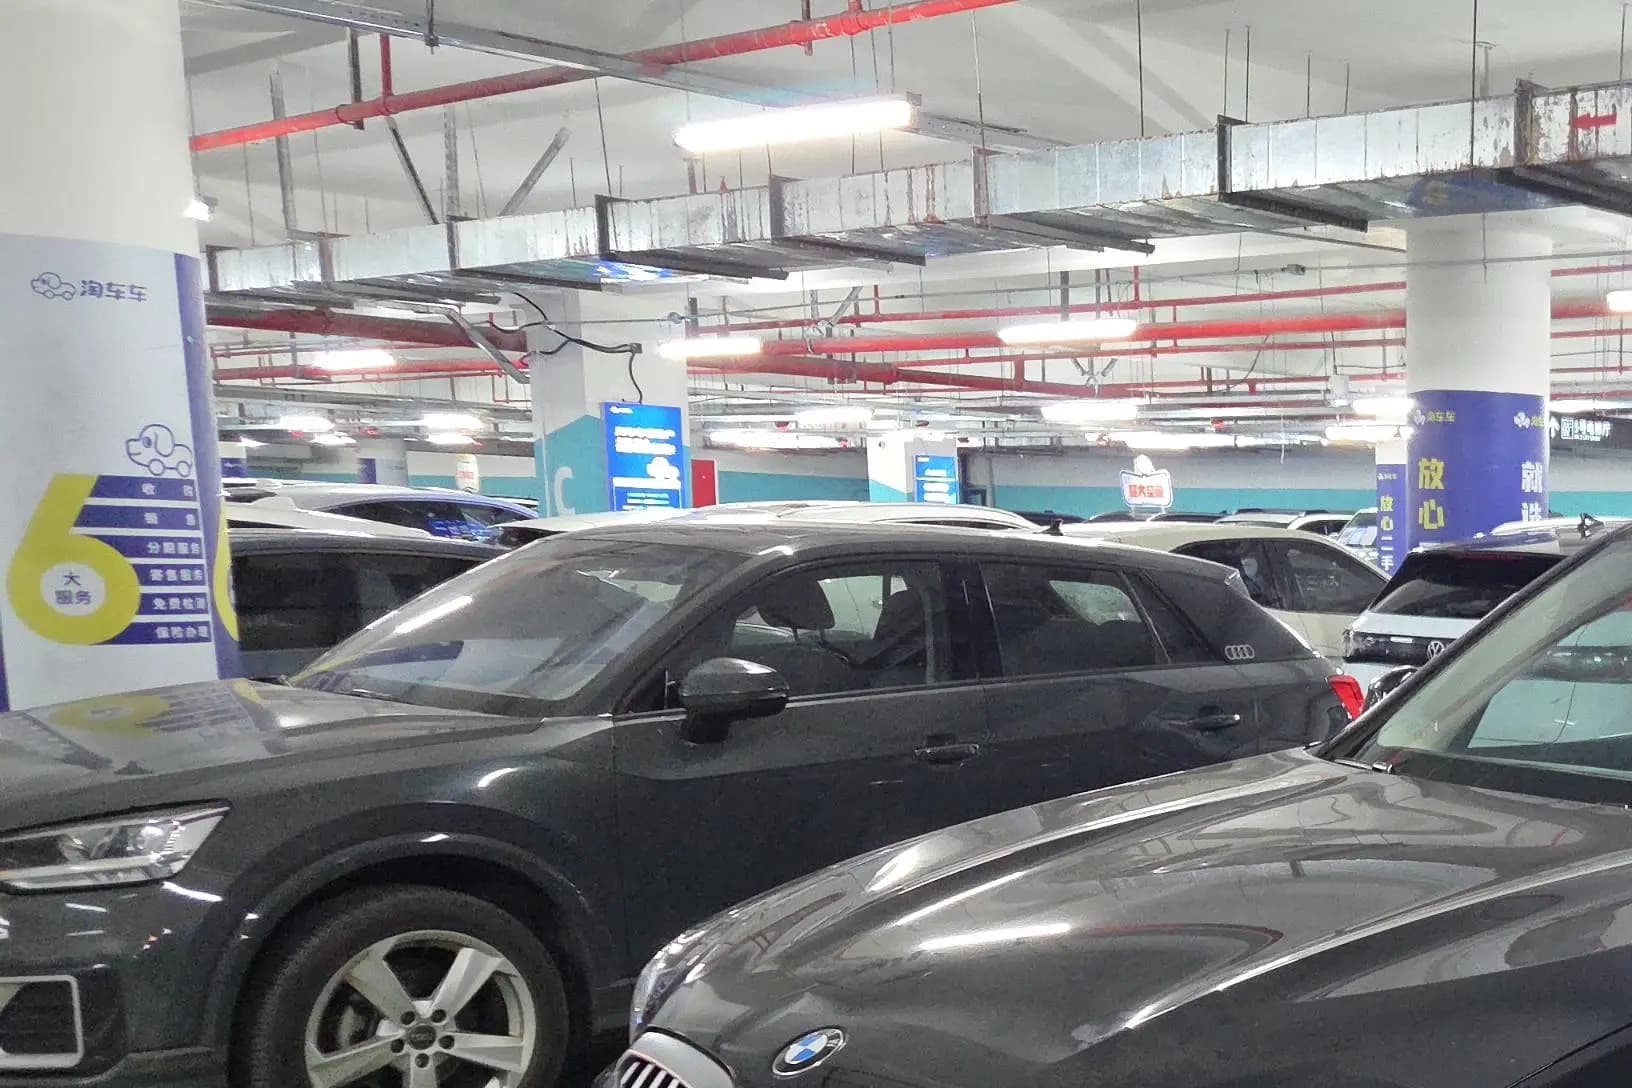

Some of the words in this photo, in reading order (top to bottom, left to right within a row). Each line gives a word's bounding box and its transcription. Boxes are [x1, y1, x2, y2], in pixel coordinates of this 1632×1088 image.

[80, 280, 147, 301] 淘车车
[1418, 458, 1445, 529] 放心
[64, 572, 81, 586] 大
[55, 590, 92, 606] 服务
